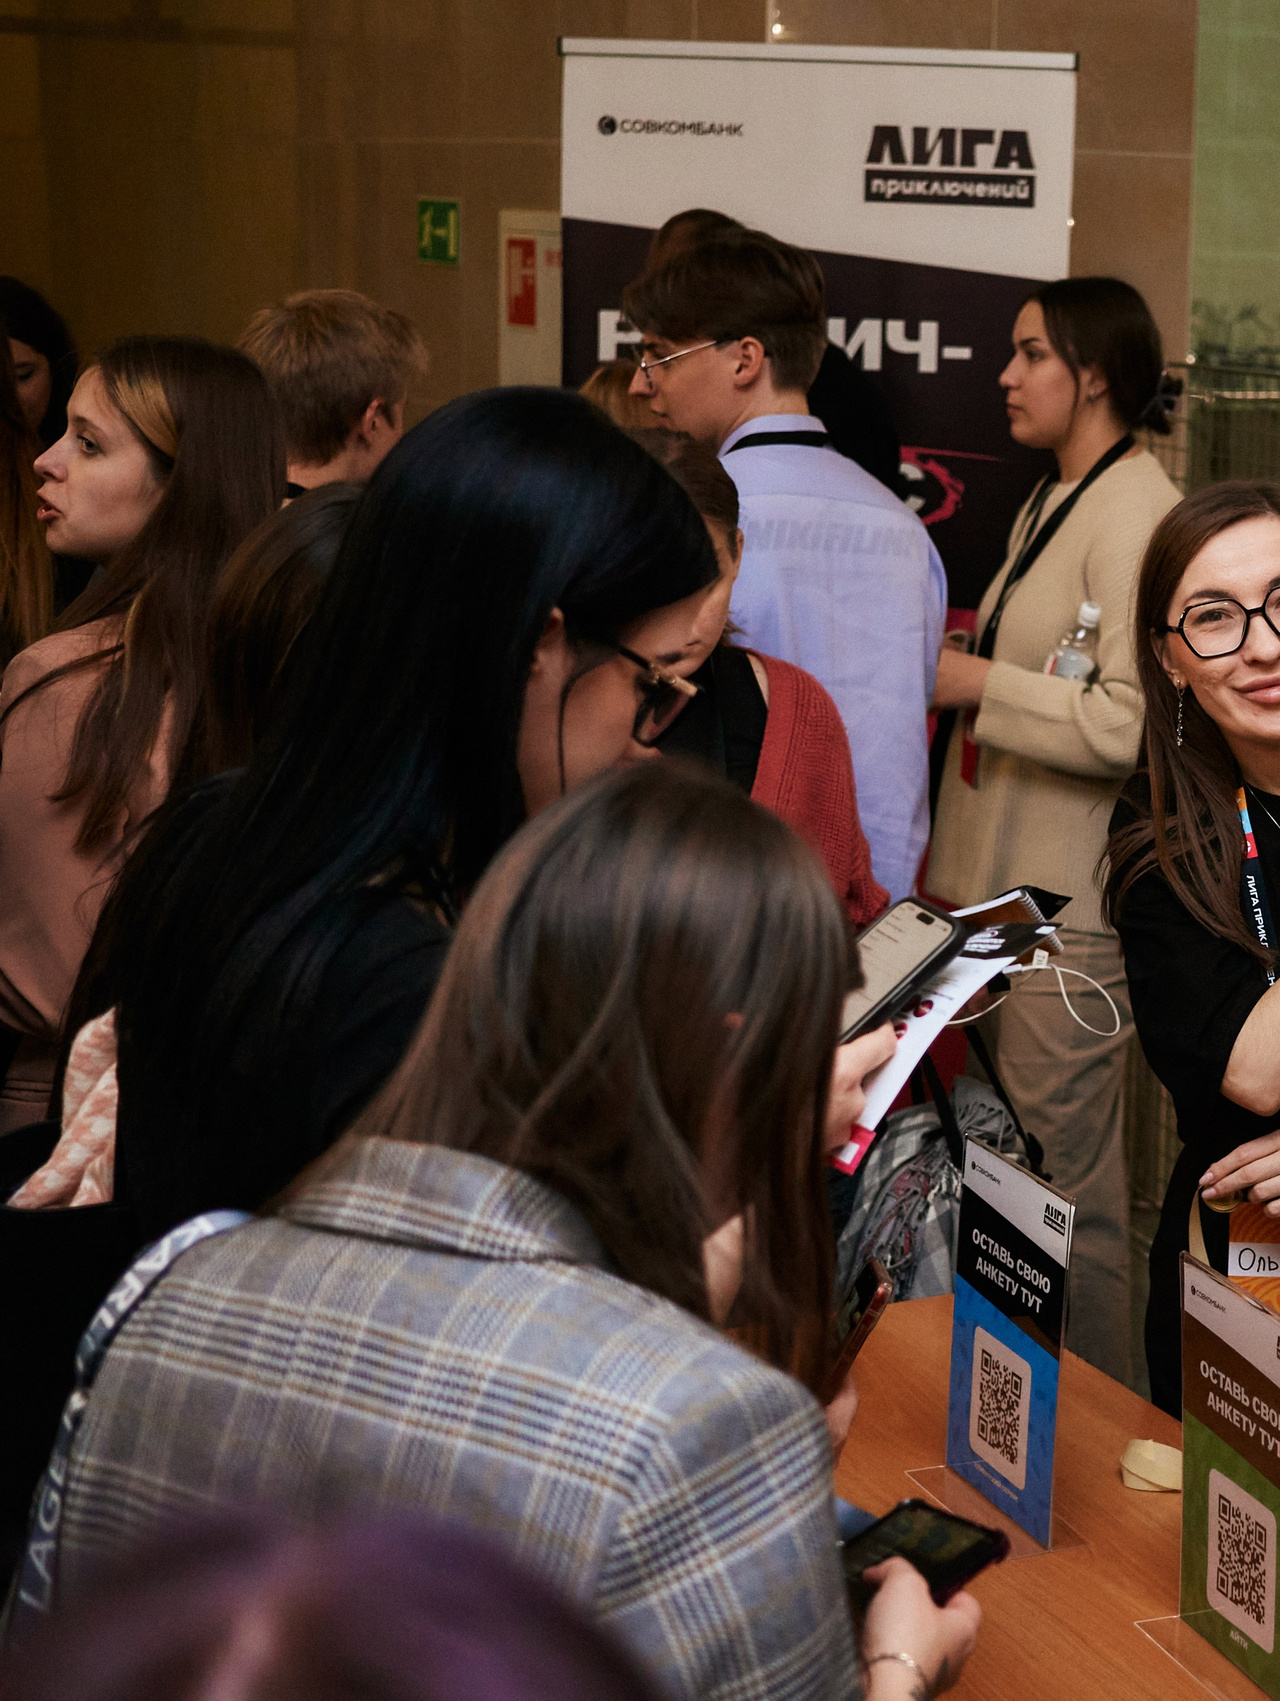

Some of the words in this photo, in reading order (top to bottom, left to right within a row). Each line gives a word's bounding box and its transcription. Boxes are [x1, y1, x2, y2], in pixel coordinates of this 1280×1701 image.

[620, 119, 744, 137] СОВКОМБАНК
[866, 125, 1035, 170] ЛИГА
[870, 178, 1031, 200] приключений
[1246, 874, 1260, 907] ЛИГА
[972, 1228, 1015, 1269] ОСТАВЬ
[1016, 1259, 1051, 1294] СВОЮ
[975, 1256, 1019, 1296] АНКЕТУ
[1020, 1286, 1043, 1313] ТУТ
[1200, 1360, 1250, 1407] ОСТАВЬ
[1207, 1391, 1257, 1437] АНКЕТУ
